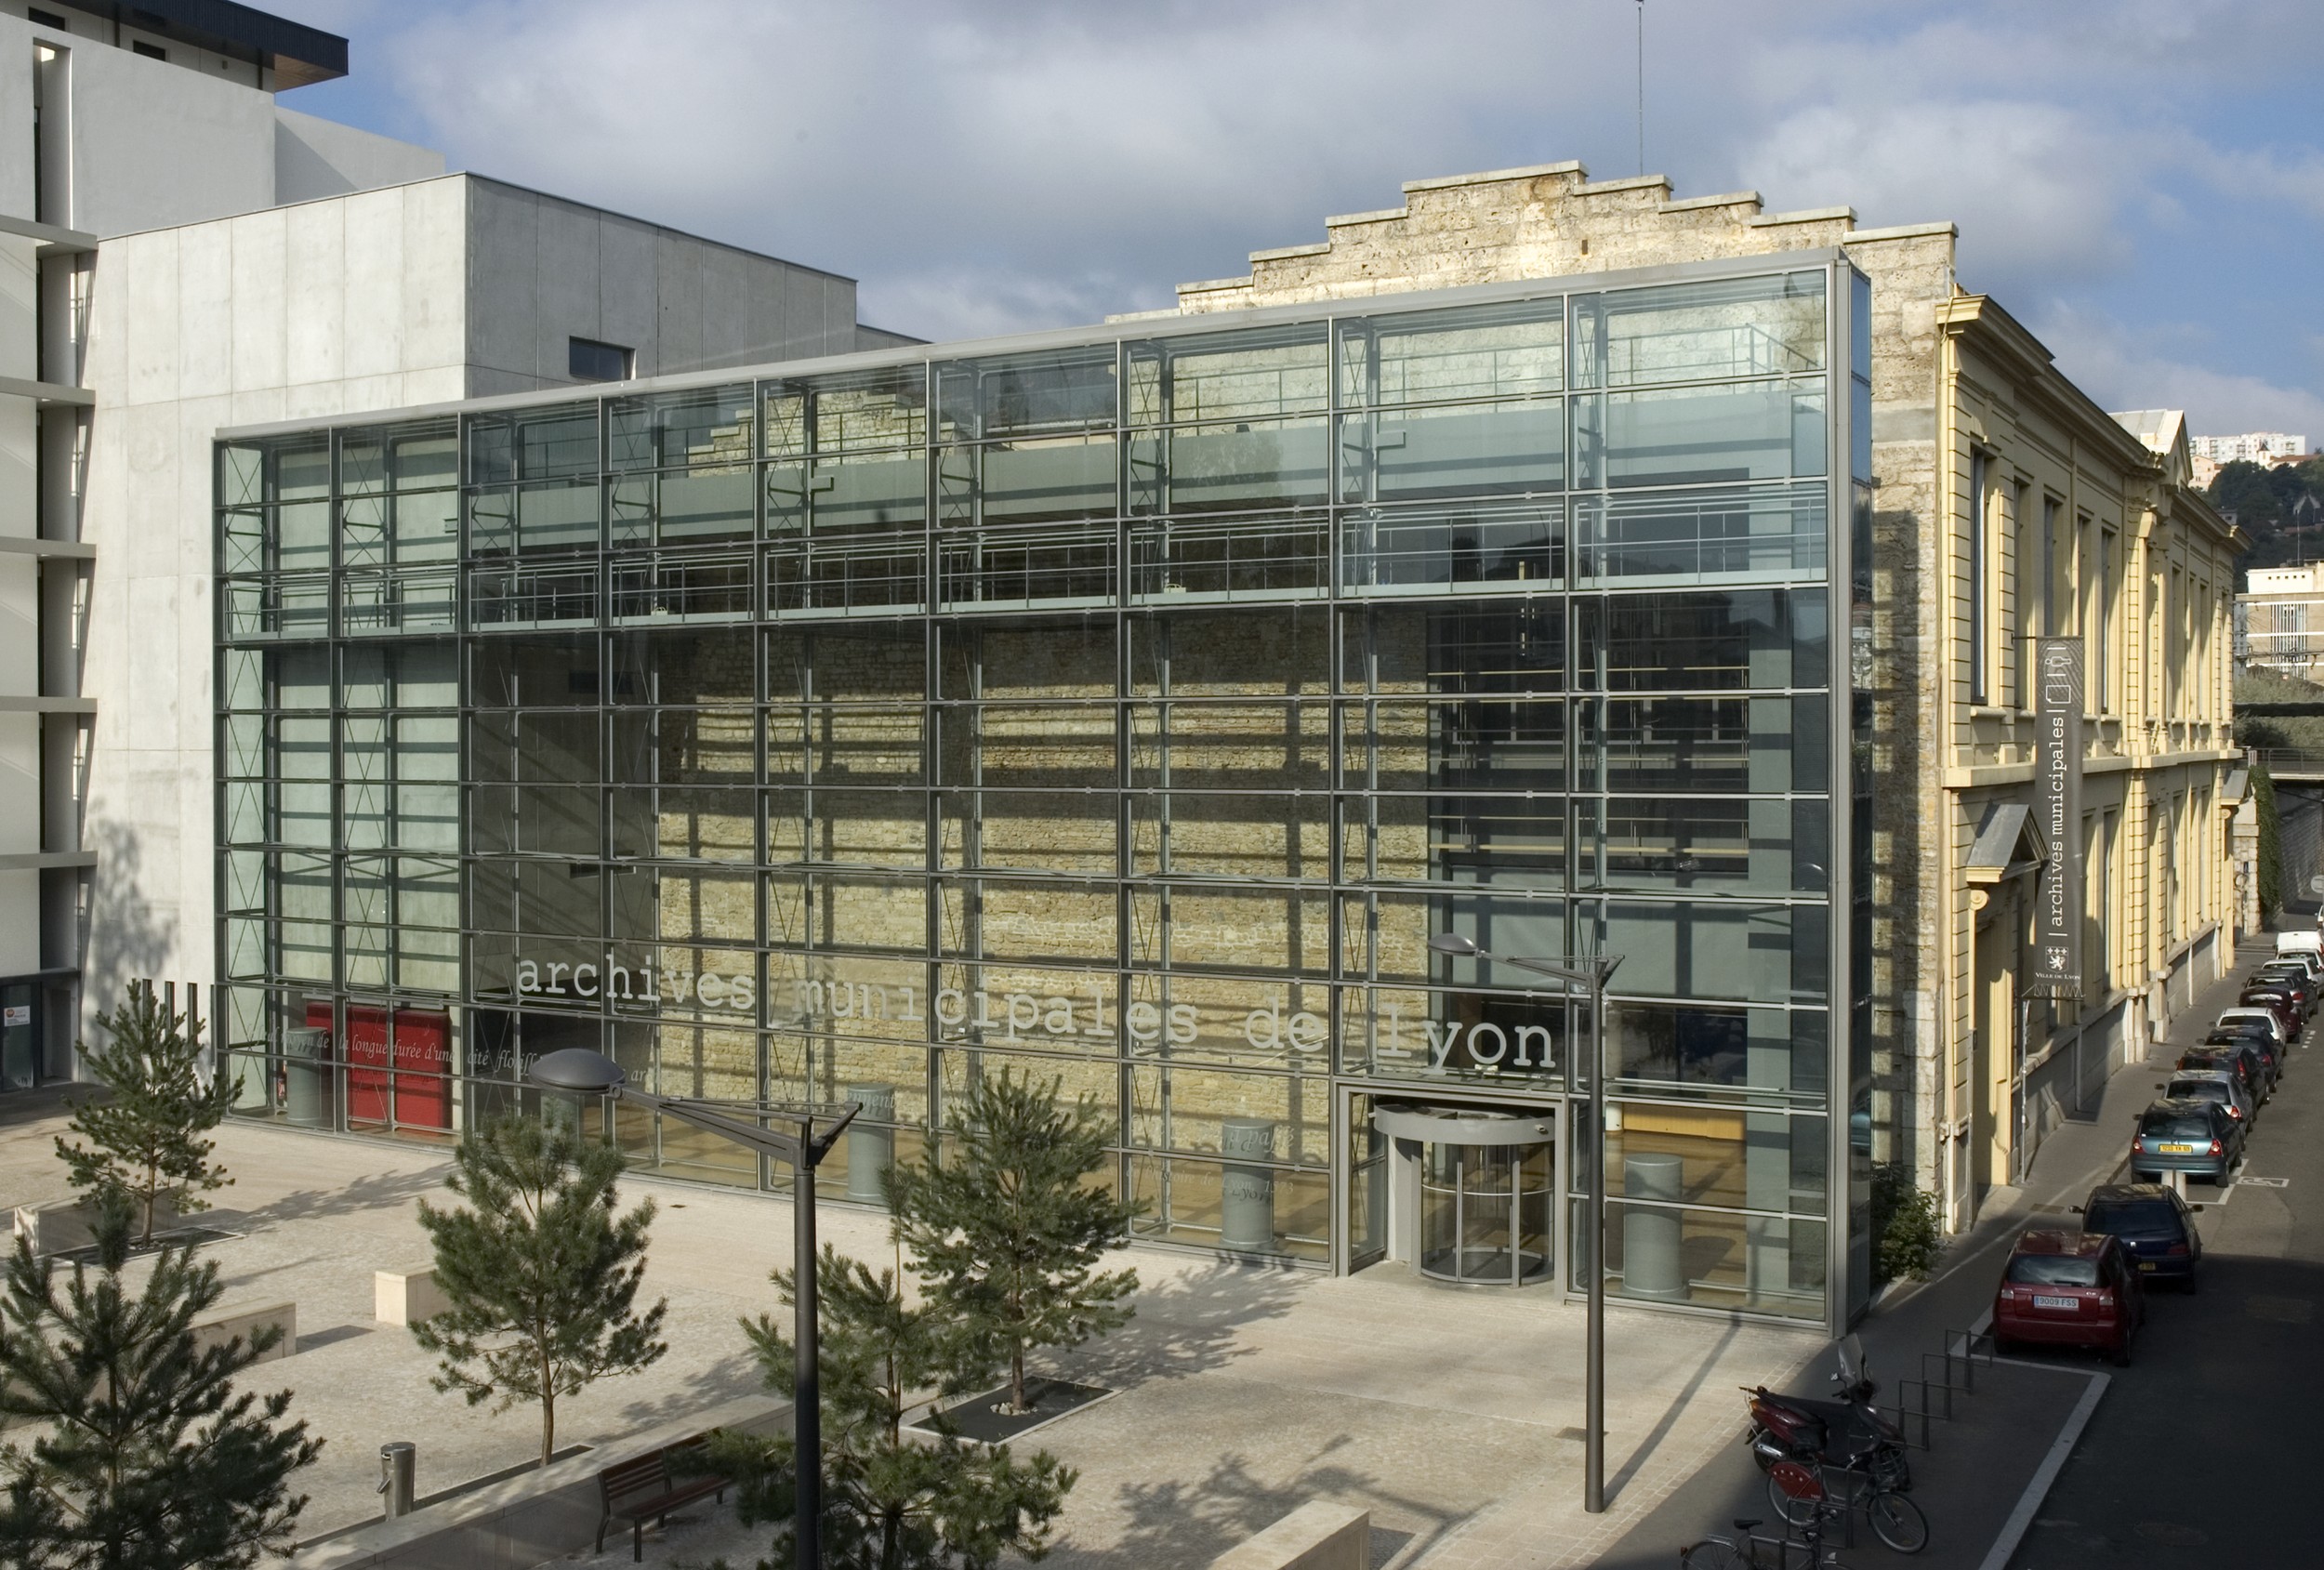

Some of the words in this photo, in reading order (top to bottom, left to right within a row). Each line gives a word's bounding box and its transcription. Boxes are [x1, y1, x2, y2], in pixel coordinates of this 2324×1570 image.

[2048, 716, 2067, 837] municipales
[2048, 840, 2063, 927] archives
[517, 953, 756, 1010] archives
[794, 974, 1198, 1045] municipales
[1245, 997, 1327, 1053] de
[1378, 1002, 1557, 1075] lyon
[317, 1031, 330, 1049] de
[338, 1034, 350, 1050] la
[352, 1034, 389, 1059] longue
[392, 1038, 421, 1060] durée
[424, 1042, 456, 1063] d'une
[467, 1049, 491, 1066] cité
[1199, 1171, 1215, 1186] de
[1263, 1180, 1294, 1195] 1573
[2040, 1297, 2059, 1306] 9009
[2061, 1298, 2077, 1307] FSS
